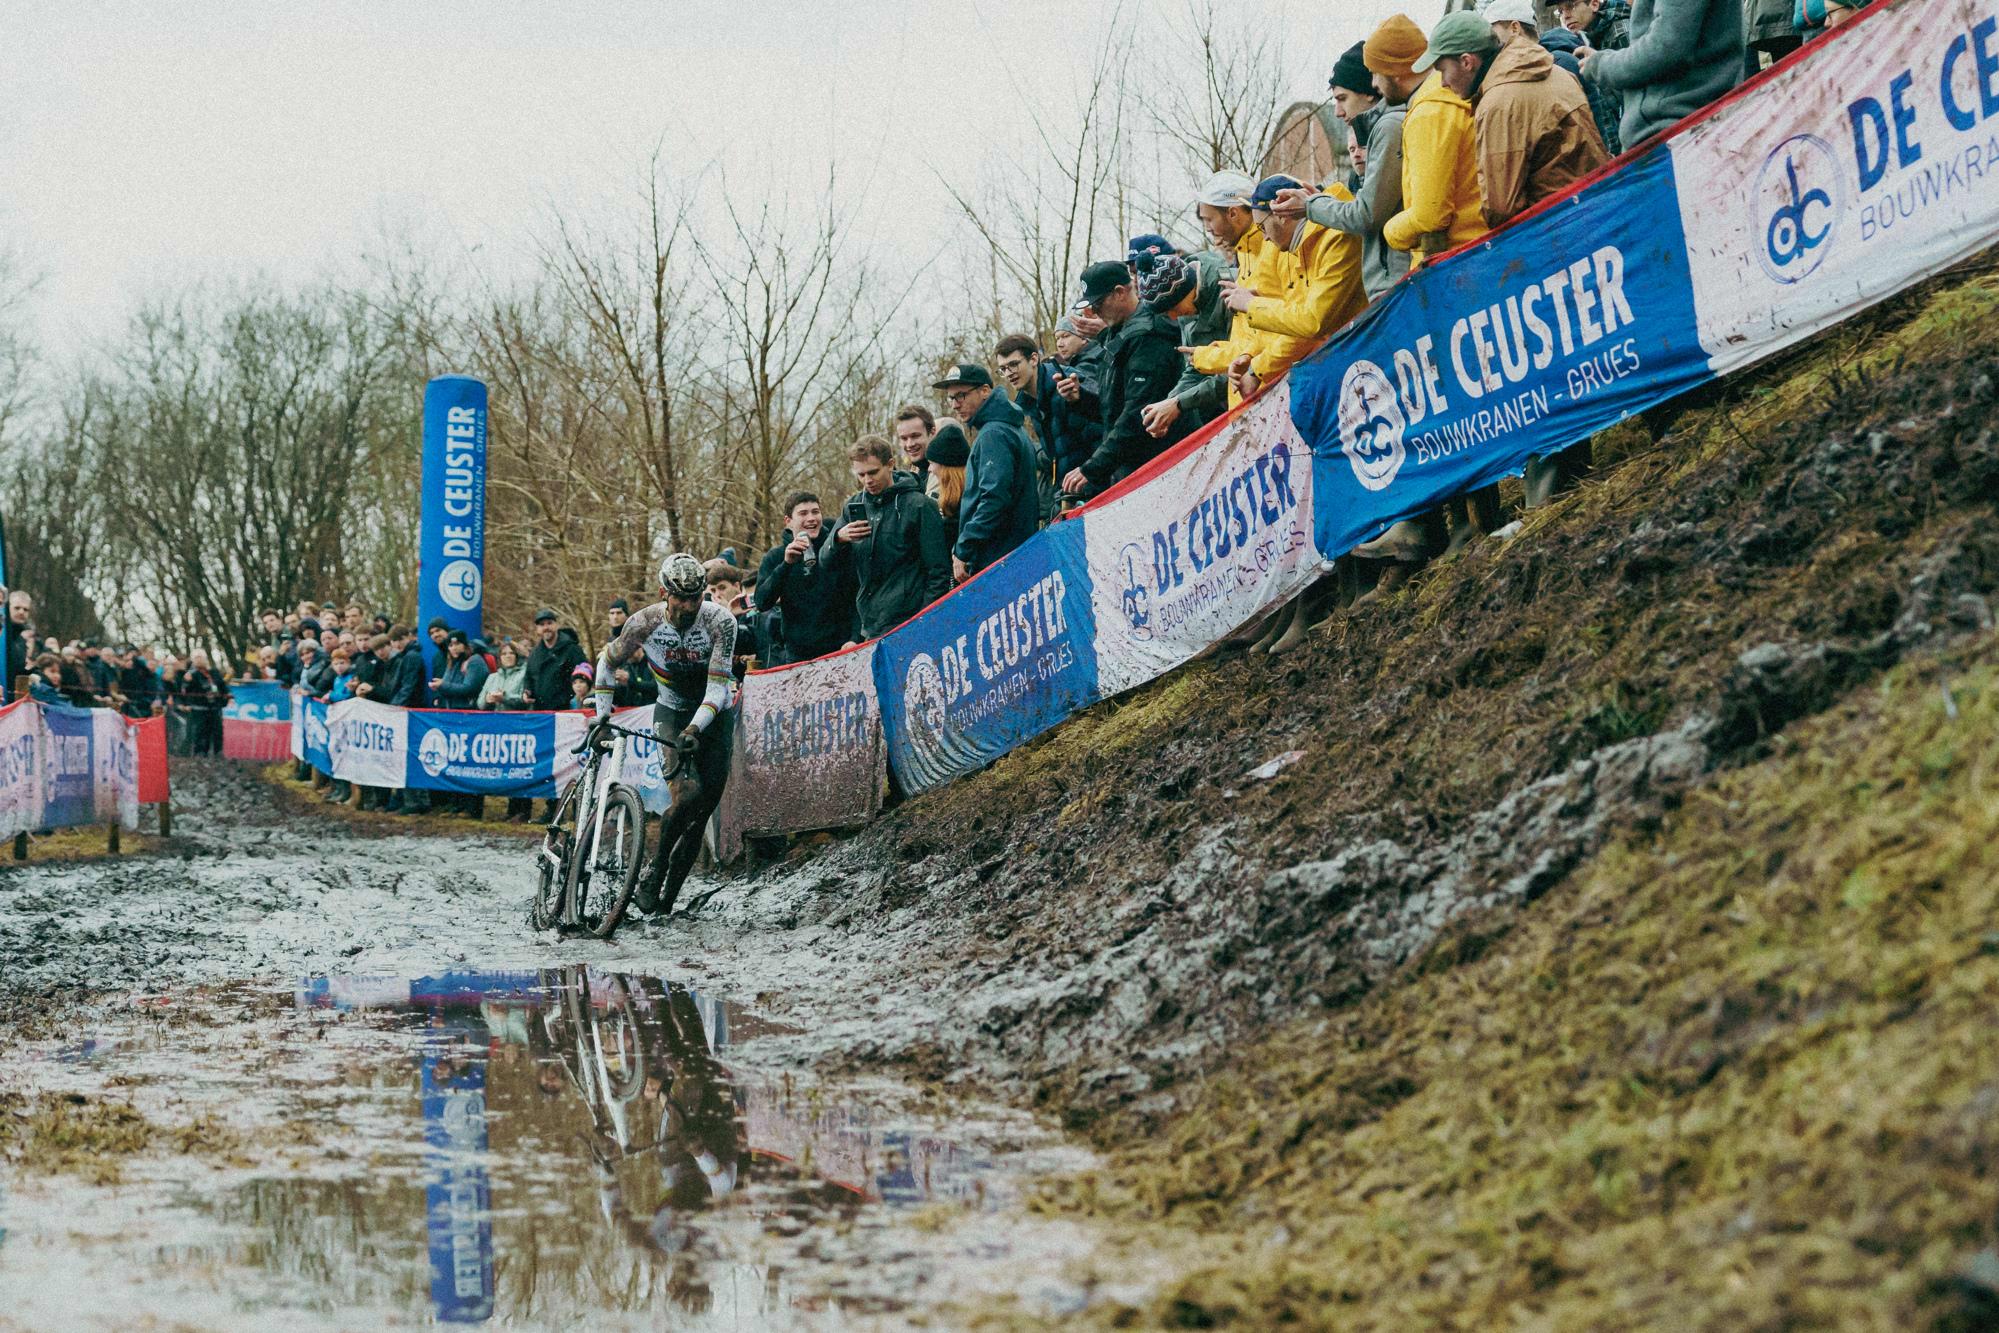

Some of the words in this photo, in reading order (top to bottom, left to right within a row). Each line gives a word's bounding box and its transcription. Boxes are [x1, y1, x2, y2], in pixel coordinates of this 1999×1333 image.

[1847, 68, 1922, 193] DE
[1393, 334, 1449, 426] DE
[1450, 245, 1635, 399] CEUSTER
[1411, 384, 1550, 465] BOUWKRANEN
[1566, 338, 1641, 401] GRUES
[444, 405, 476, 518] CEUSTER
[443, 525, 472, 559] DE
[1152, 521, 1184, 597] DE
[1188, 442, 1297, 574] CEUSTER
[719, 618, 735, 658] Alpecin
[942, 634, 973, 705] DE
[976, 570, 1068, 681] CEUSTER
[1160, 565, 1243, 633] BOUWKRANEN
[1038, 640, 1074, 681] GRUES
[448, 733, 469, 762] DE
[471, 733, 537, 764] CEUSTER
[790, 690, 868, 760] CEUSTER
